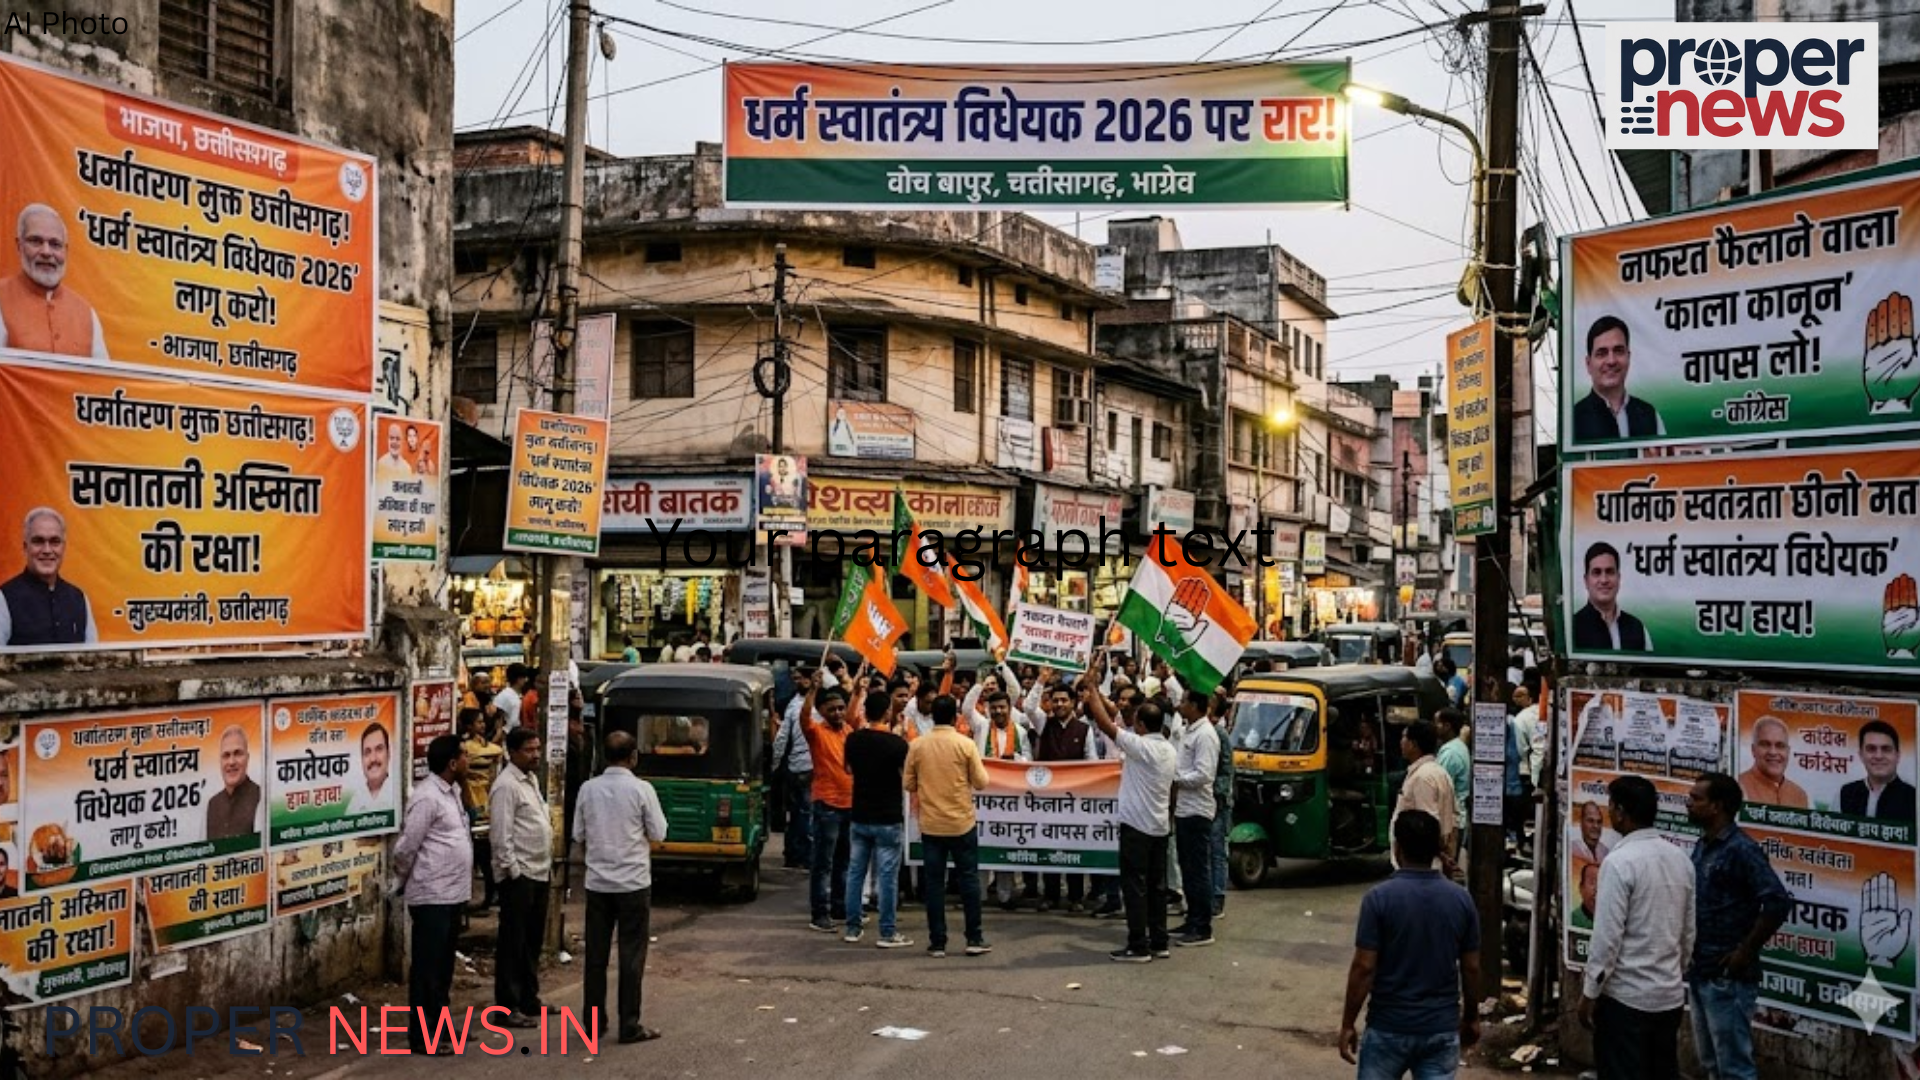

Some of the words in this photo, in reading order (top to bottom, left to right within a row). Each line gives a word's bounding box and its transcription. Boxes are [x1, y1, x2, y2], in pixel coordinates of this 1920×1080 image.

[119, 106, 188, 150] भाजपा,
[744, 85, 808, 141] धर्म
[816, 88, 947, 142] स्वातंत्र्य
[953, 87, 1085, 142] विधेयक
[1095, 99, 1192, 142] 2026
[1202, 99, 1252, 141] पर
[1261, 96, 1337, 142] रार!
[887, 166, 931, 193] वोच
[937, 169, 999, 202] बापुर,
[197, 179, 244, 223] मुक्त
[249, 189, 349, 245] छत्तीसगढ़!
[134, 225, 217, 266] स्वातंत्र्य
[223, 233, 296, 279] विधेयक
[1619, 240, 1709, 283] नफरत
[1715, 214, 1814, 269] फैलाने
[1820, 208, 1899, 253] वाला
[175, 281, 226, 327] लागू
[227, 287, 276, 324] करो!
[164, 335, 223, 367] भाजपा,
[228, 340, 297, 376] छत्तीसगढ़
[1682, 343, 1758, 383] वापस
[1767, 329, 1820, 375] लो!
[179, 405, 219, 441] मुक्त
[226, 405, 315, 448] छत्तीसगढ़!
[69, 458, 204, 509] सनातनी
[213, 463, 322, 514] अस्मिता
[659, 488, 742, 515] बातक
[1596, 476, 1678, 523] धार्मिक
[1682, 478, 1784, 521] स्वतंत्रता
[1791, 470, 1862, 518] छीनो
[1867, 480, 1920, 516] मत
[141, 522, 185, 573] की
[191, 534, 260, 572] रक्षा!
[1682, 535, 1778, 577] स्वातंत्र्य
[217, 593, 290, 625] छत्तीसगढ़
[1696, 600, 1745, 634] हाय
[1752, 600, 1813, 635] हाय!
[132, 744, 199, 777] स्वातंत्र्य
[75, 788, 145, 823] विधेयक
[110, 824, 143, 849] लागू
[144, 815, 177, 839] करो!
[989, 820, 1037, 844] कानून
[1041, 824, 1089, 840] वापस
[1092, 820, 1122, 841] लो
[0, 896, 54, 931] नातनी
[60, 888, 127, 920] अस्मिता
[27, 928, 58, 962] की
[64, 919, 114, 956] रक्षा!
[1759, 970, 1811, 1001] ाजपा,
